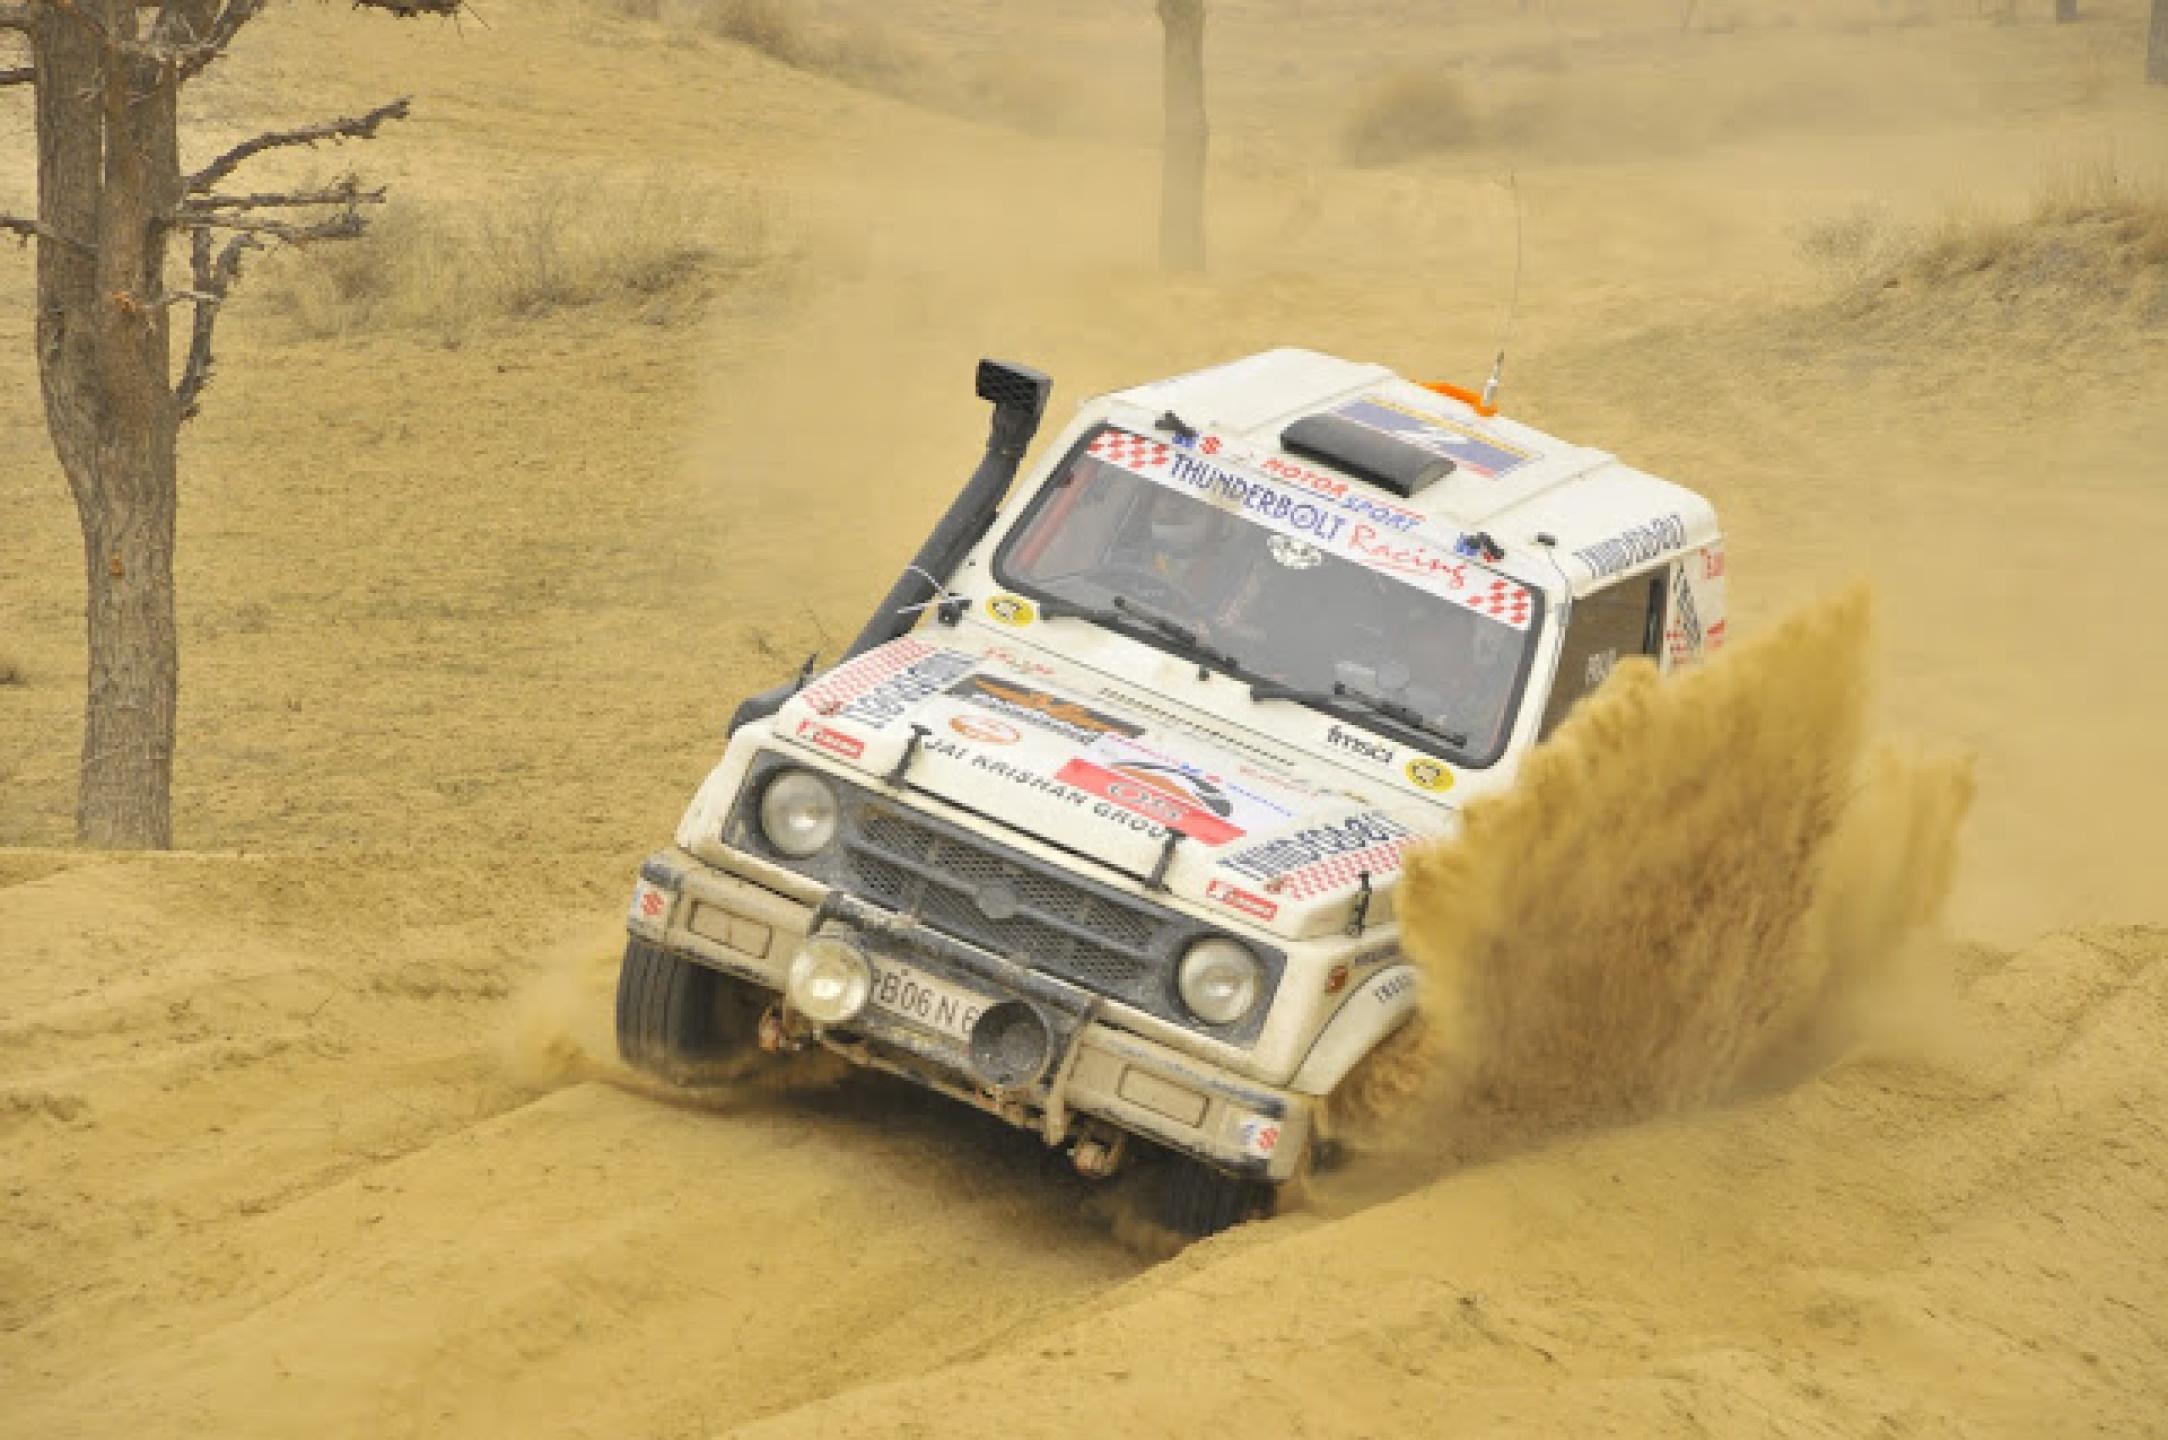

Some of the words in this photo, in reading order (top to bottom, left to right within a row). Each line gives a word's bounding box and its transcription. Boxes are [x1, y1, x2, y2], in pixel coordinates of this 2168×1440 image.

[1261, 457, 1346, 499] MOTOR
[1168, 452, 1347, 543] THUNDERBOLT
[1348, 523, 1467, 590] Racing
[1341, 494, 1420, 533] SPORT
[924, 739, 967, 761] JAI
[971, 754, 1088, 805] KRISHAN
[934, 994, 960, 1026] N
